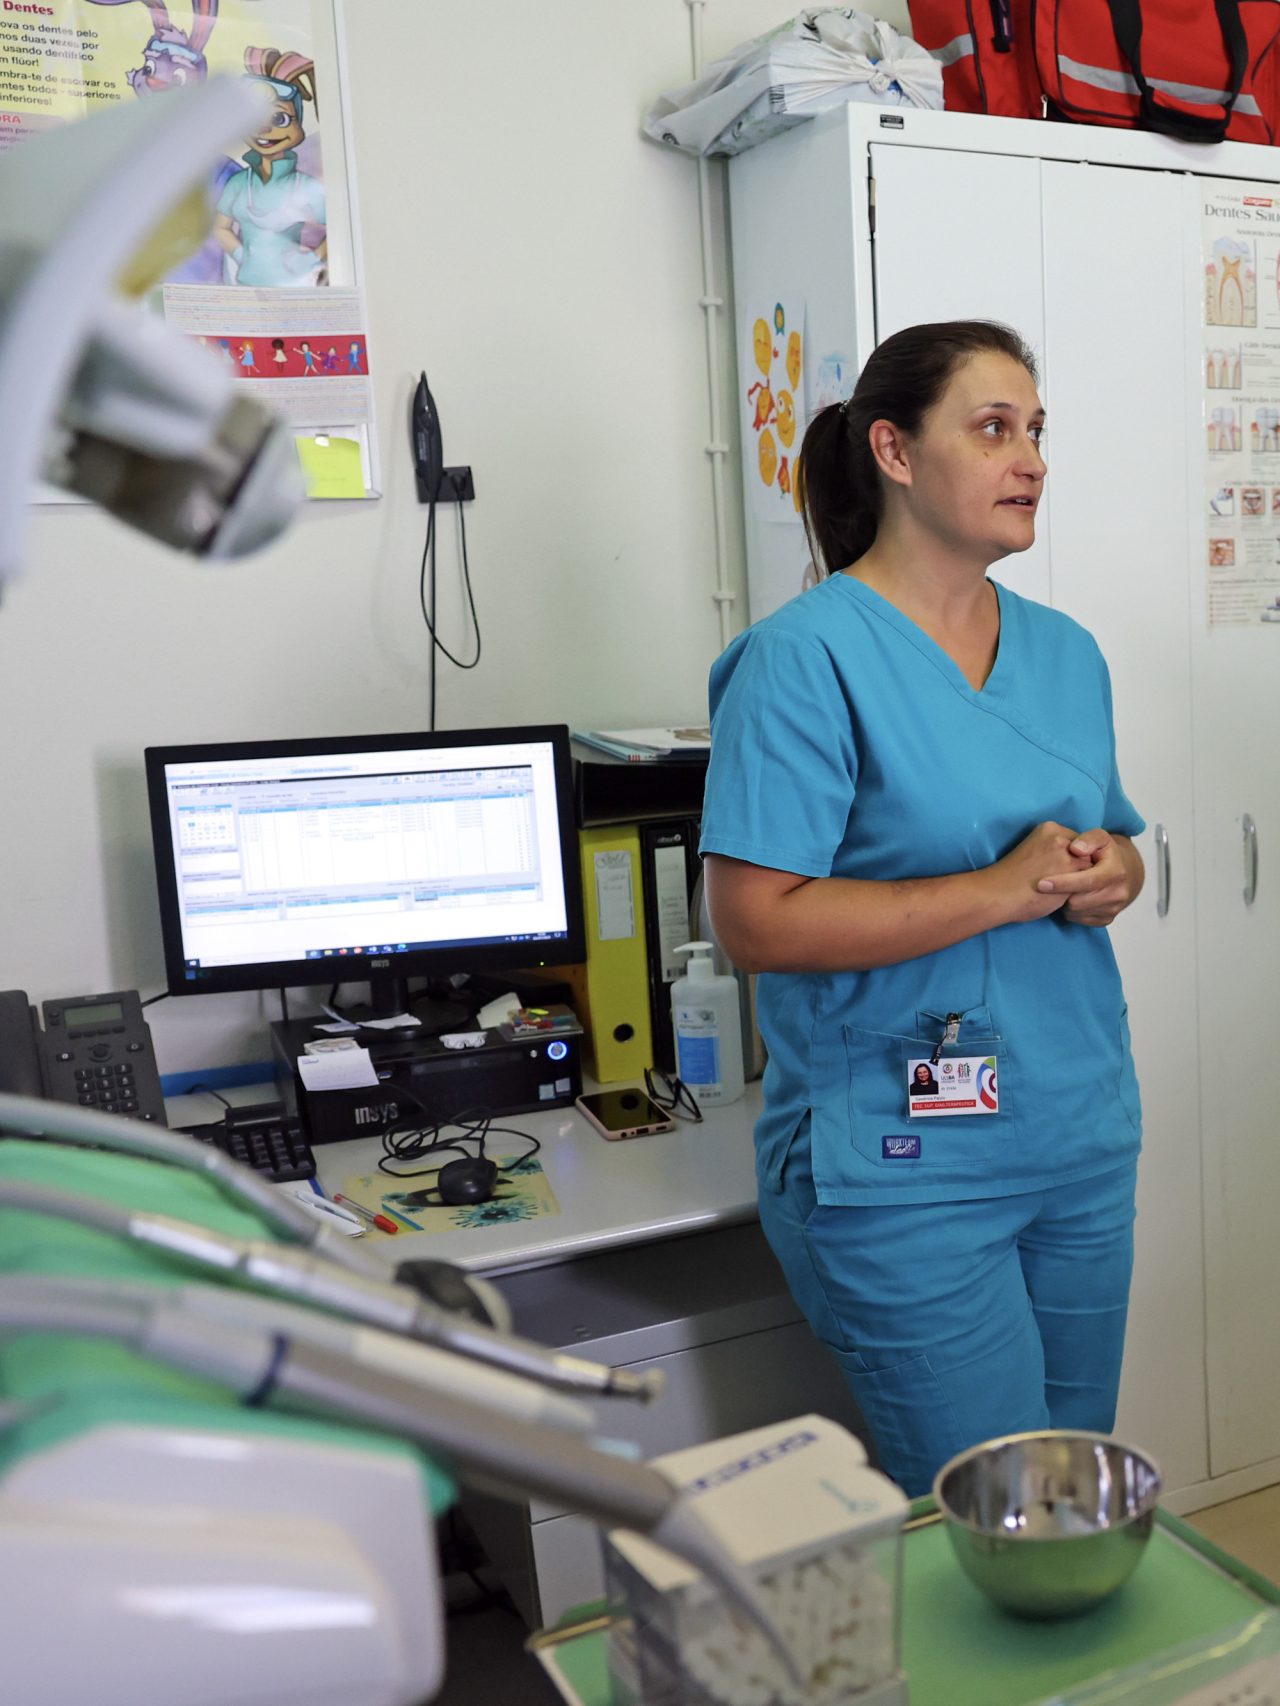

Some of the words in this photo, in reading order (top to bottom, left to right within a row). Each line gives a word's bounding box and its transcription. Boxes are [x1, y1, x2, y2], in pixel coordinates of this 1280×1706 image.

[3, 0, 54, 16] Dentes
[38, 24, 73, 35] dentes
[76, 29, 98, 38] pelo
[3, 44, 42, 55] usando
[21, 33, 47, 44] duas
[49, 39, 79, 48] vezes
[81, 41, 99, 50] por
[11, 56, 39, 67] flúor!
[45, 73, 57, 83] de
[103, 81, 116, 89] os
[27, 84, 57, 95] todos
[67, 88, 121, 100] superiores
[0, 114, 21, 124] RA
[1204, 203, 1251, 219] Dentes
